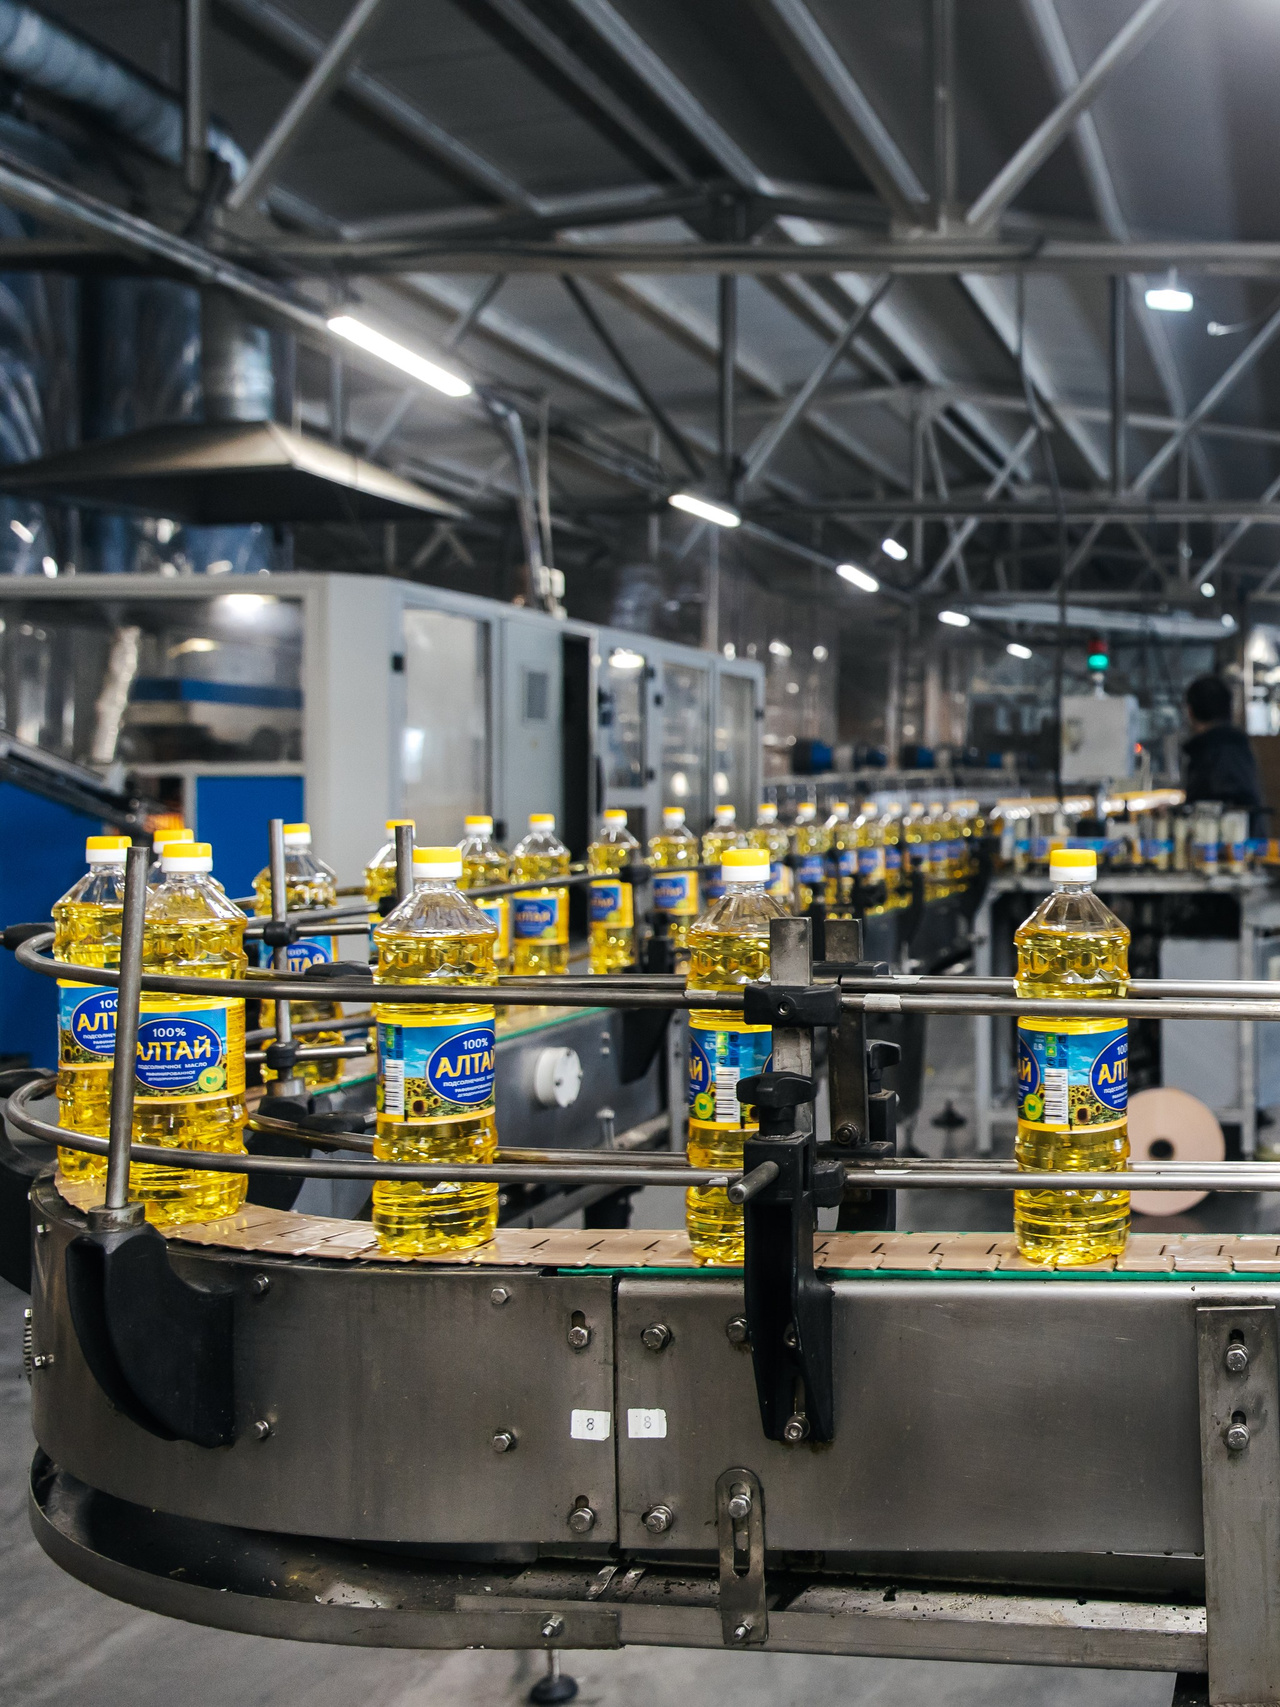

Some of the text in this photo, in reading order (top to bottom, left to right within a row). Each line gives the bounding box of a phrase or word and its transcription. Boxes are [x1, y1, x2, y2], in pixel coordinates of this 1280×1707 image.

[99, 999, 118, 1009] 100
[77, 1011, 118, 1032] АЛТ
[152, 1027, 187, 1038] 100%
[136, 1035, 212, 1063] АЛТАЙ
[463, 1037, 488, 1049] 100%
[1097, 1058, 1128, 1086] АЛТ
[586, 1417, 595, 1431] 8
[643, 1415, 652, 1430] 8
